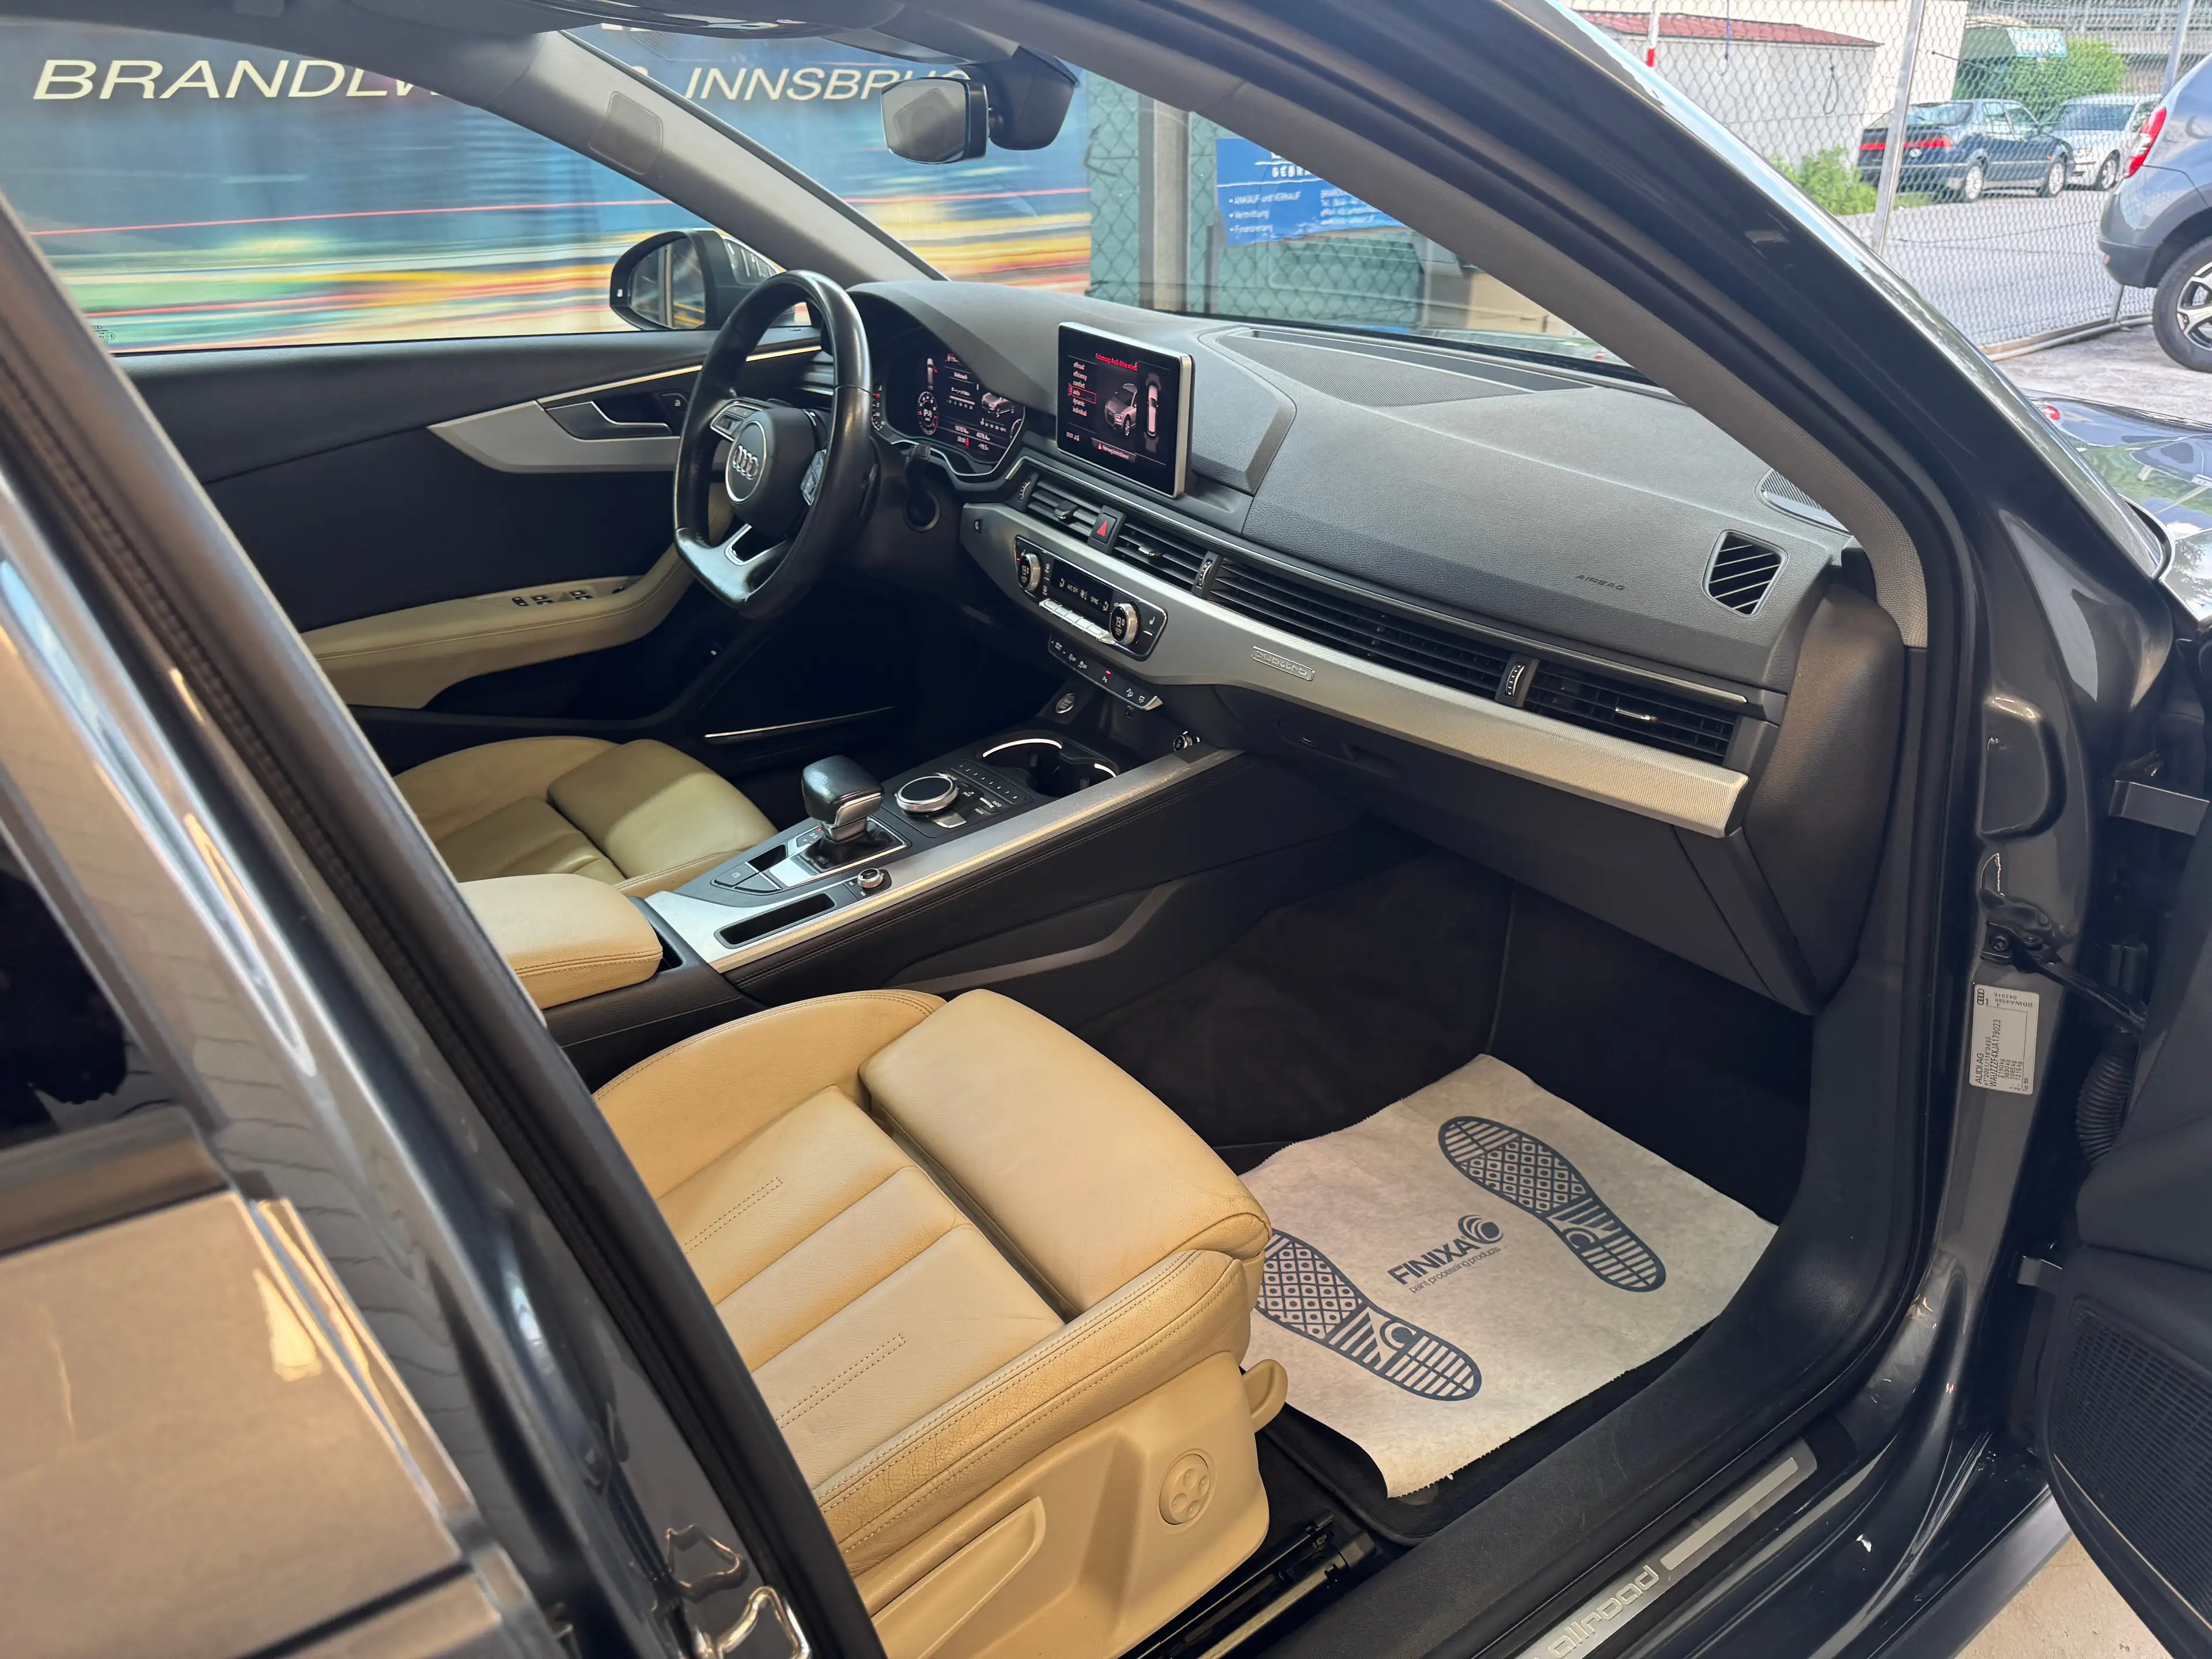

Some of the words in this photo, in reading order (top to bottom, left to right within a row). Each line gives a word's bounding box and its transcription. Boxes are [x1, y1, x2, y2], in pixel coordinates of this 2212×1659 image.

[1575, 575, 1626, 591] AIRBAG
[1255, 650, 1307, 676] quattro
[1976, 1052, 1984, 1064] AG
[1975, 1064, 1983, 1084] AUDI
[1387, 1238, 1481, 1285] FINIXA
[1409, 1280, 1429, 1294] paint
[1427, 1259, 1471, 1285] processing
[1467, 1247, 1502, 1267] products
[1548, 1565, 1660, 1659] allroad
